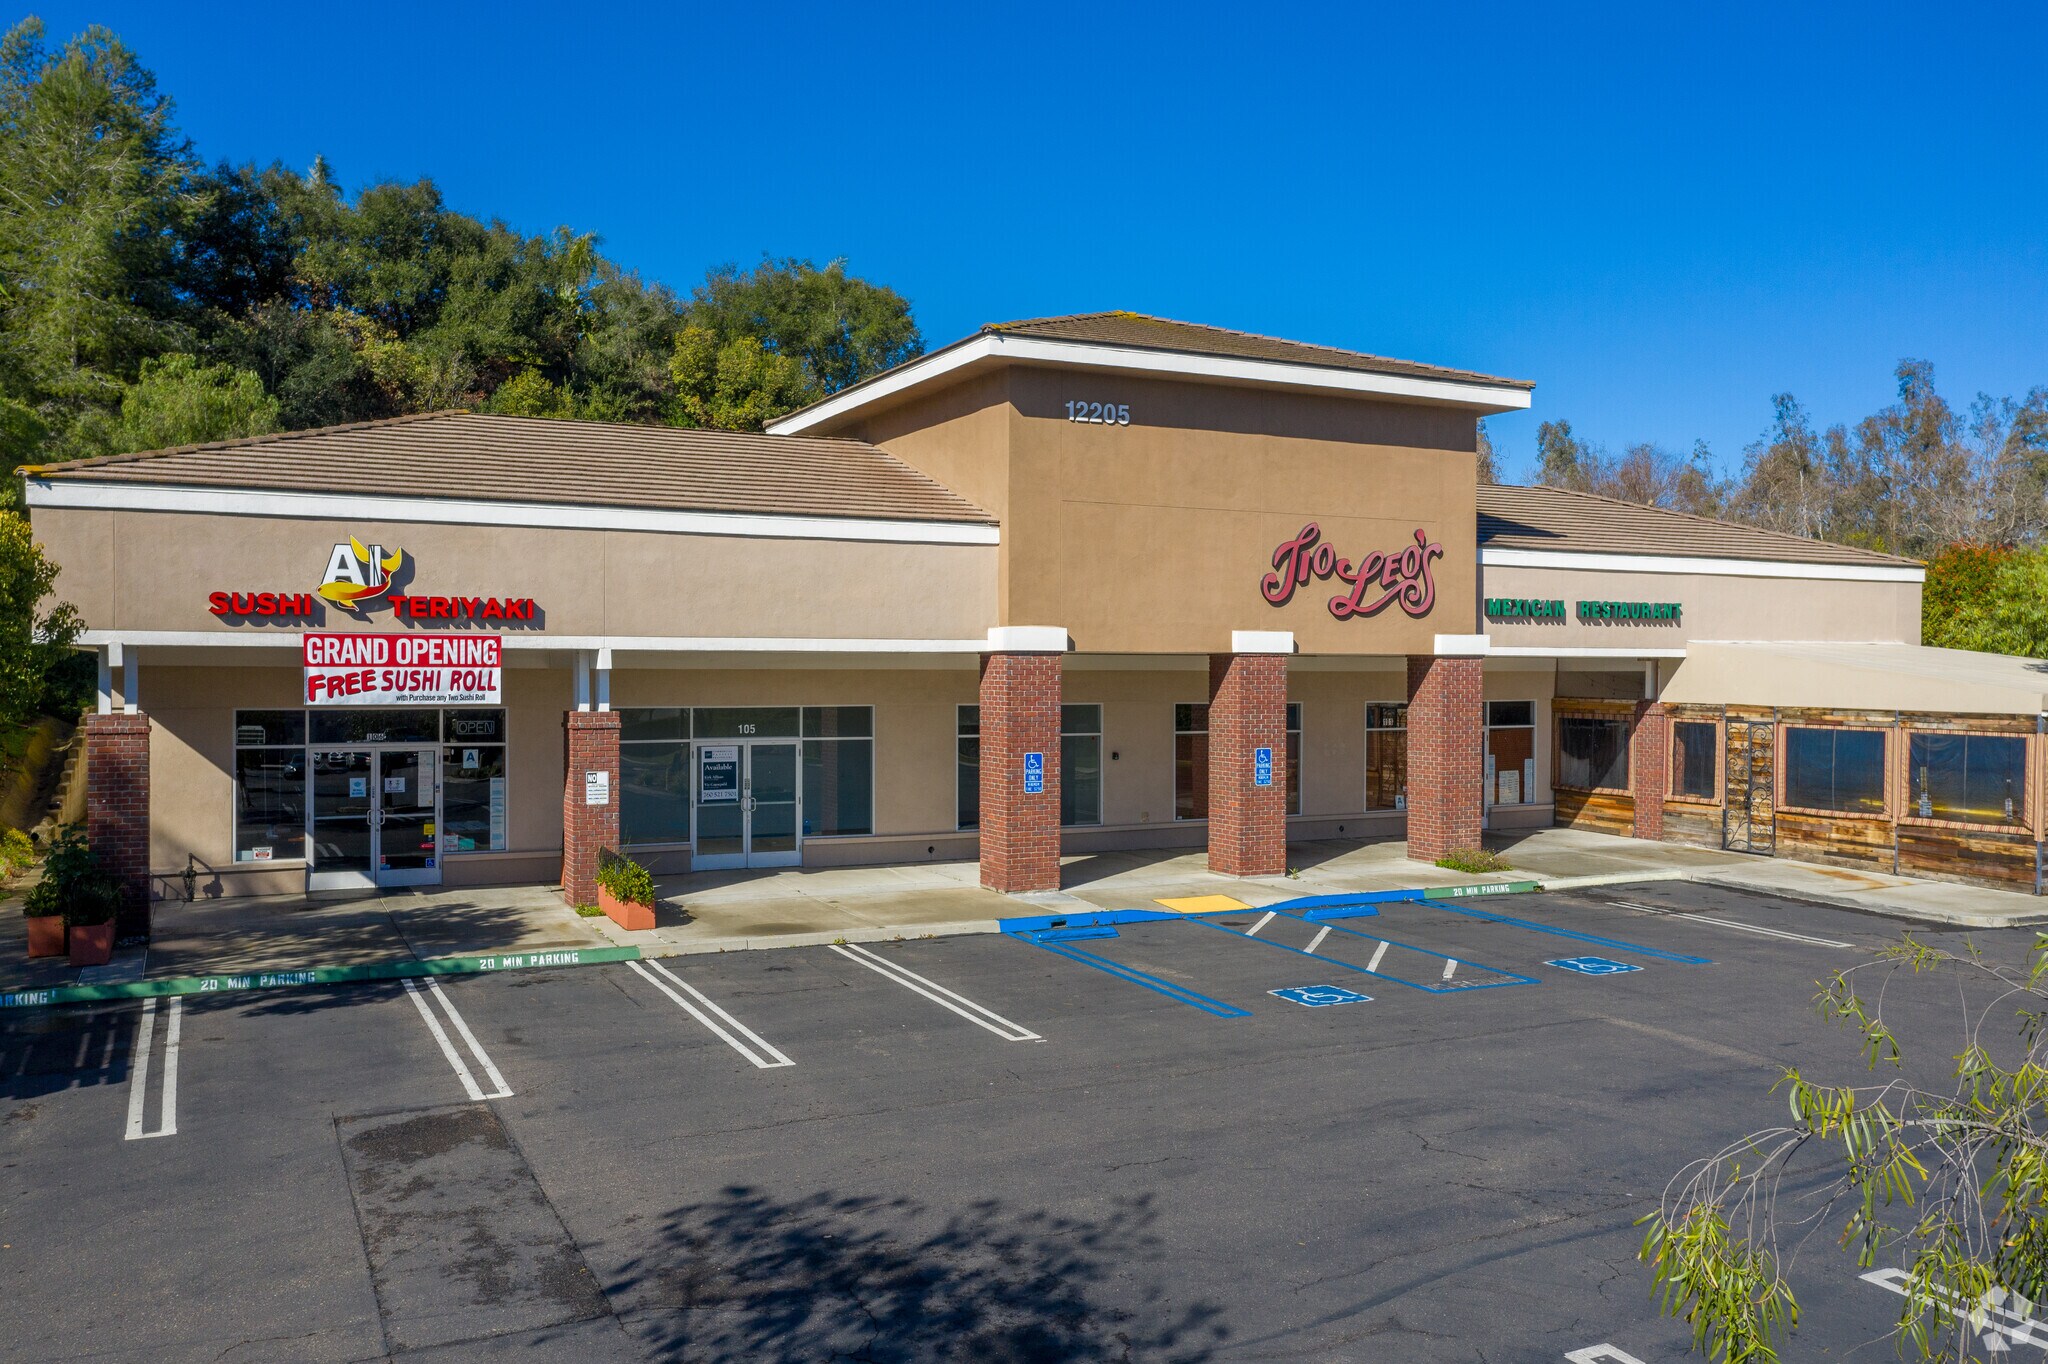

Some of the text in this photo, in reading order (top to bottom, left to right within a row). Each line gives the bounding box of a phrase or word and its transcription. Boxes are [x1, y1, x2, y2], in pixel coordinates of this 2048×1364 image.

[1065, 400, 1130, 425] 12205
[208, 591, 534, 619] SUSHI TERIYAKI
[1488, 598, 1682, 619] MEXICAN RESTAURANT
[306, 637, 498, 665] GRAND OPENING
[307, 669, 497, 702] FREE SUSHI ROLL
[395, 693, 408, 701] with
[409, 693, 436, 701] Purchase
[459, 693, 474, 701] Sushi
[475, 693, 485, 701] Roll
[459, 722, 493, 733] OPEN
[738, 724, 756, 734] 105
[466, 752, 476, 761] A
[704, 763, 733, 771] Available
[587, 774, 597, 783] NO
[1453, 884, 1510, 896] 20 MIN PARKING
[480, 952, 579, 969] 20 MIN PARKING
[200, 971, 316, 991] 20 MIN PARKING
[0, 991, 48, 1007] RKING
